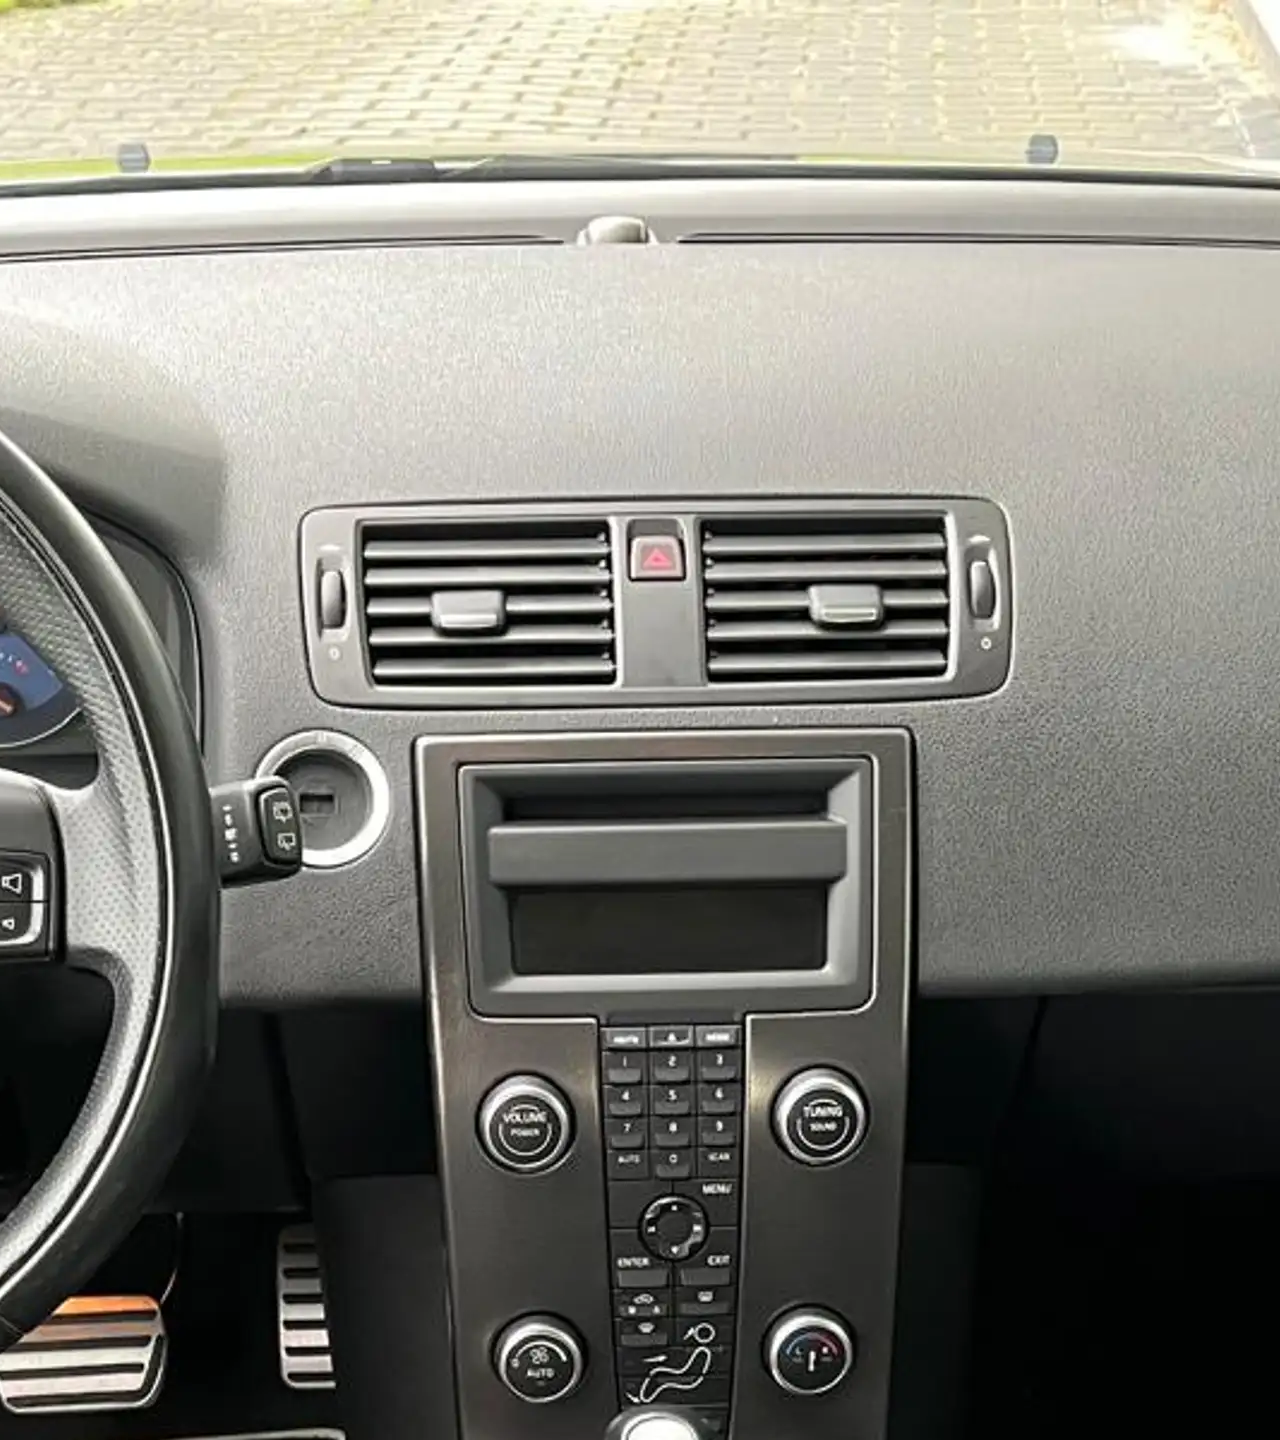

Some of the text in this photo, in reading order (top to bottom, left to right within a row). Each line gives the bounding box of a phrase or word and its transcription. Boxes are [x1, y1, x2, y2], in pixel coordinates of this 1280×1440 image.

[621, 1055, 628, 1067] 1
[667, 1054, 678, 1067] 2
[620, 1089, 631, 1101] 4
[502, 1111, 548, 1124] VOLUME
[802, 1105, 844, 1118] TUNING
[623, 1122, 632, 1133] 7
[668, 1121, 678, 1133] 8
[668, 1153, 679, 1164] 0
[701, 1183, 733, 1194] MENU
[617, 1257, 649, 1269] ENTER
[707, 1254, 731, 1267] EXIT
